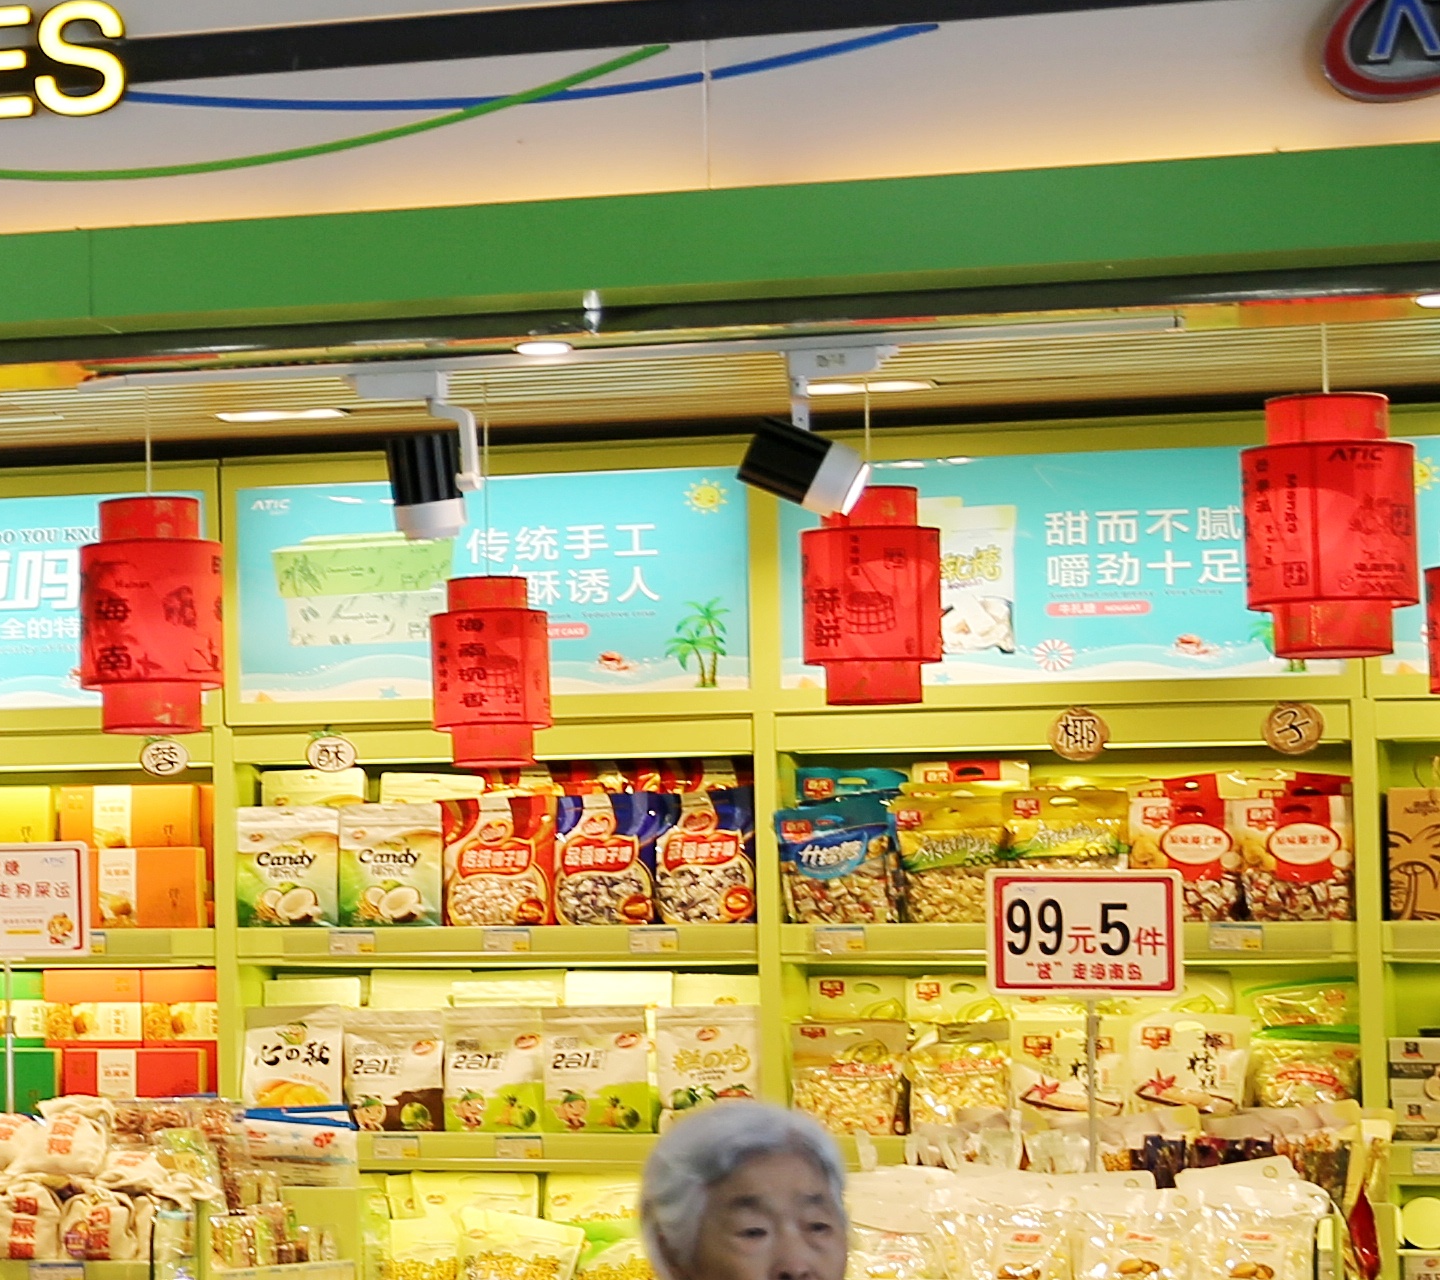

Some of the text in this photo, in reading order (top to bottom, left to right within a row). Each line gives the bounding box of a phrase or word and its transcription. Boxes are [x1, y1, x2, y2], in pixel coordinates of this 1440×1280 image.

[1327, 447, 1385, 463] ATIC
[466, 524, 659, 564] 传统手工
[1045, 506, 1242, 545] 甜而不腻
[1046, 549, 1243, 587] 嚼劲十足
[95, 598, 131, 673] 海南
[1276, 709, 1312, 745] 子
[257, 850, 318, 869] Candy
[358, 848, 421, 867] Candy
[1006, 898, 1166, 957] 99元5件
[1071, 962, 1143, 982] 走海南岛
